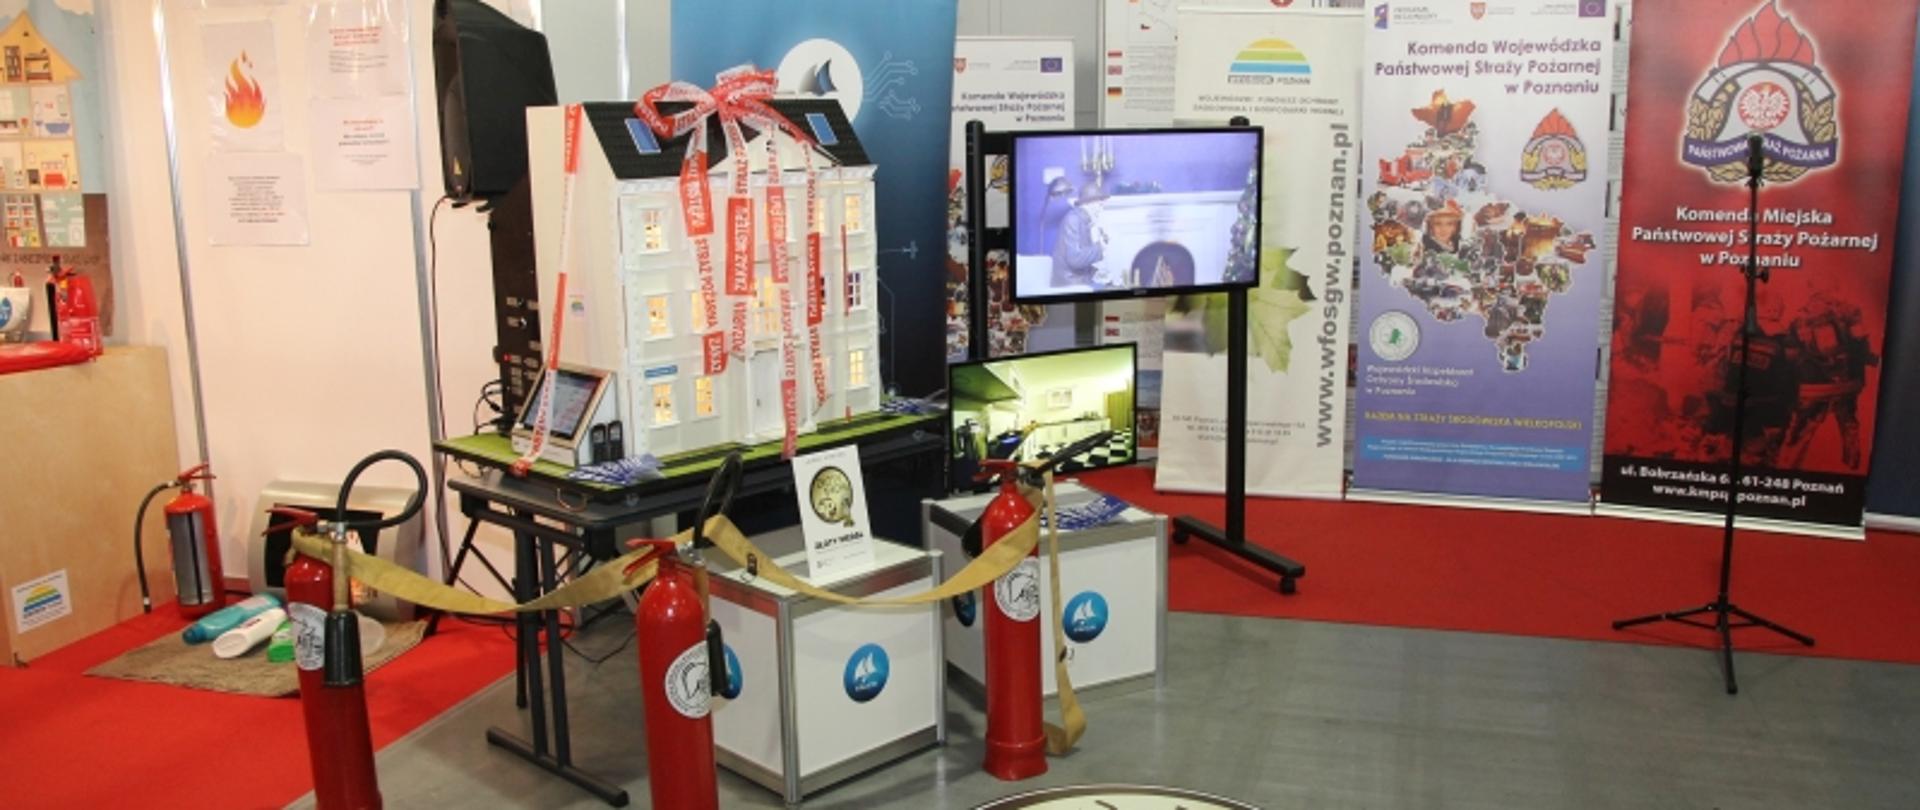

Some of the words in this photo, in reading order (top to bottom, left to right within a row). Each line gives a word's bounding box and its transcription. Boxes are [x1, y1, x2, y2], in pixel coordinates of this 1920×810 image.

[1408, 41, 1488, 56] Komenda
[1493, 37, 1601, 56] Wojewódzka
[1375, 60, 1470, 78] Państwowej
[1475, 60, 1522, 77] Straży
[1528, 58, 1601, 76] Pożarnej
[962, 91, 1005, 100] Komenda
[1008, 91, 1065, 101] Wojewódzka
[1505, 84, 1519, 94] w
[1524, 80, 1599, 95] Poznaniu
[952, 102, 997, 113] aństwowej
[1026, 114, 1065, 122] Poznaniu
[1783, 145, 1830, 160] POŻARNA
[1763, 207, 1833, 225] Miejska
[1632, 226, 1733, 247] Państwowej
[1738, 230, 1793, 248] Sraży
[1797, 232, 1879, 252] Pożarnej
[695, 238, 715, 274] STRAŻ
[1700, 253, 1714, 264] w
[1317, 123, 1353, 448] www.wfosgw.poznan.pl
[701, 276, 718, 328] POŻARNA
[1621, 465, 1637, 477] ul.
[1639, 466, 1716, 485] Bobrzańska
[1742, 475, 1790, 490] 61-248
[1792, 476, 1844, 494] Poznań
